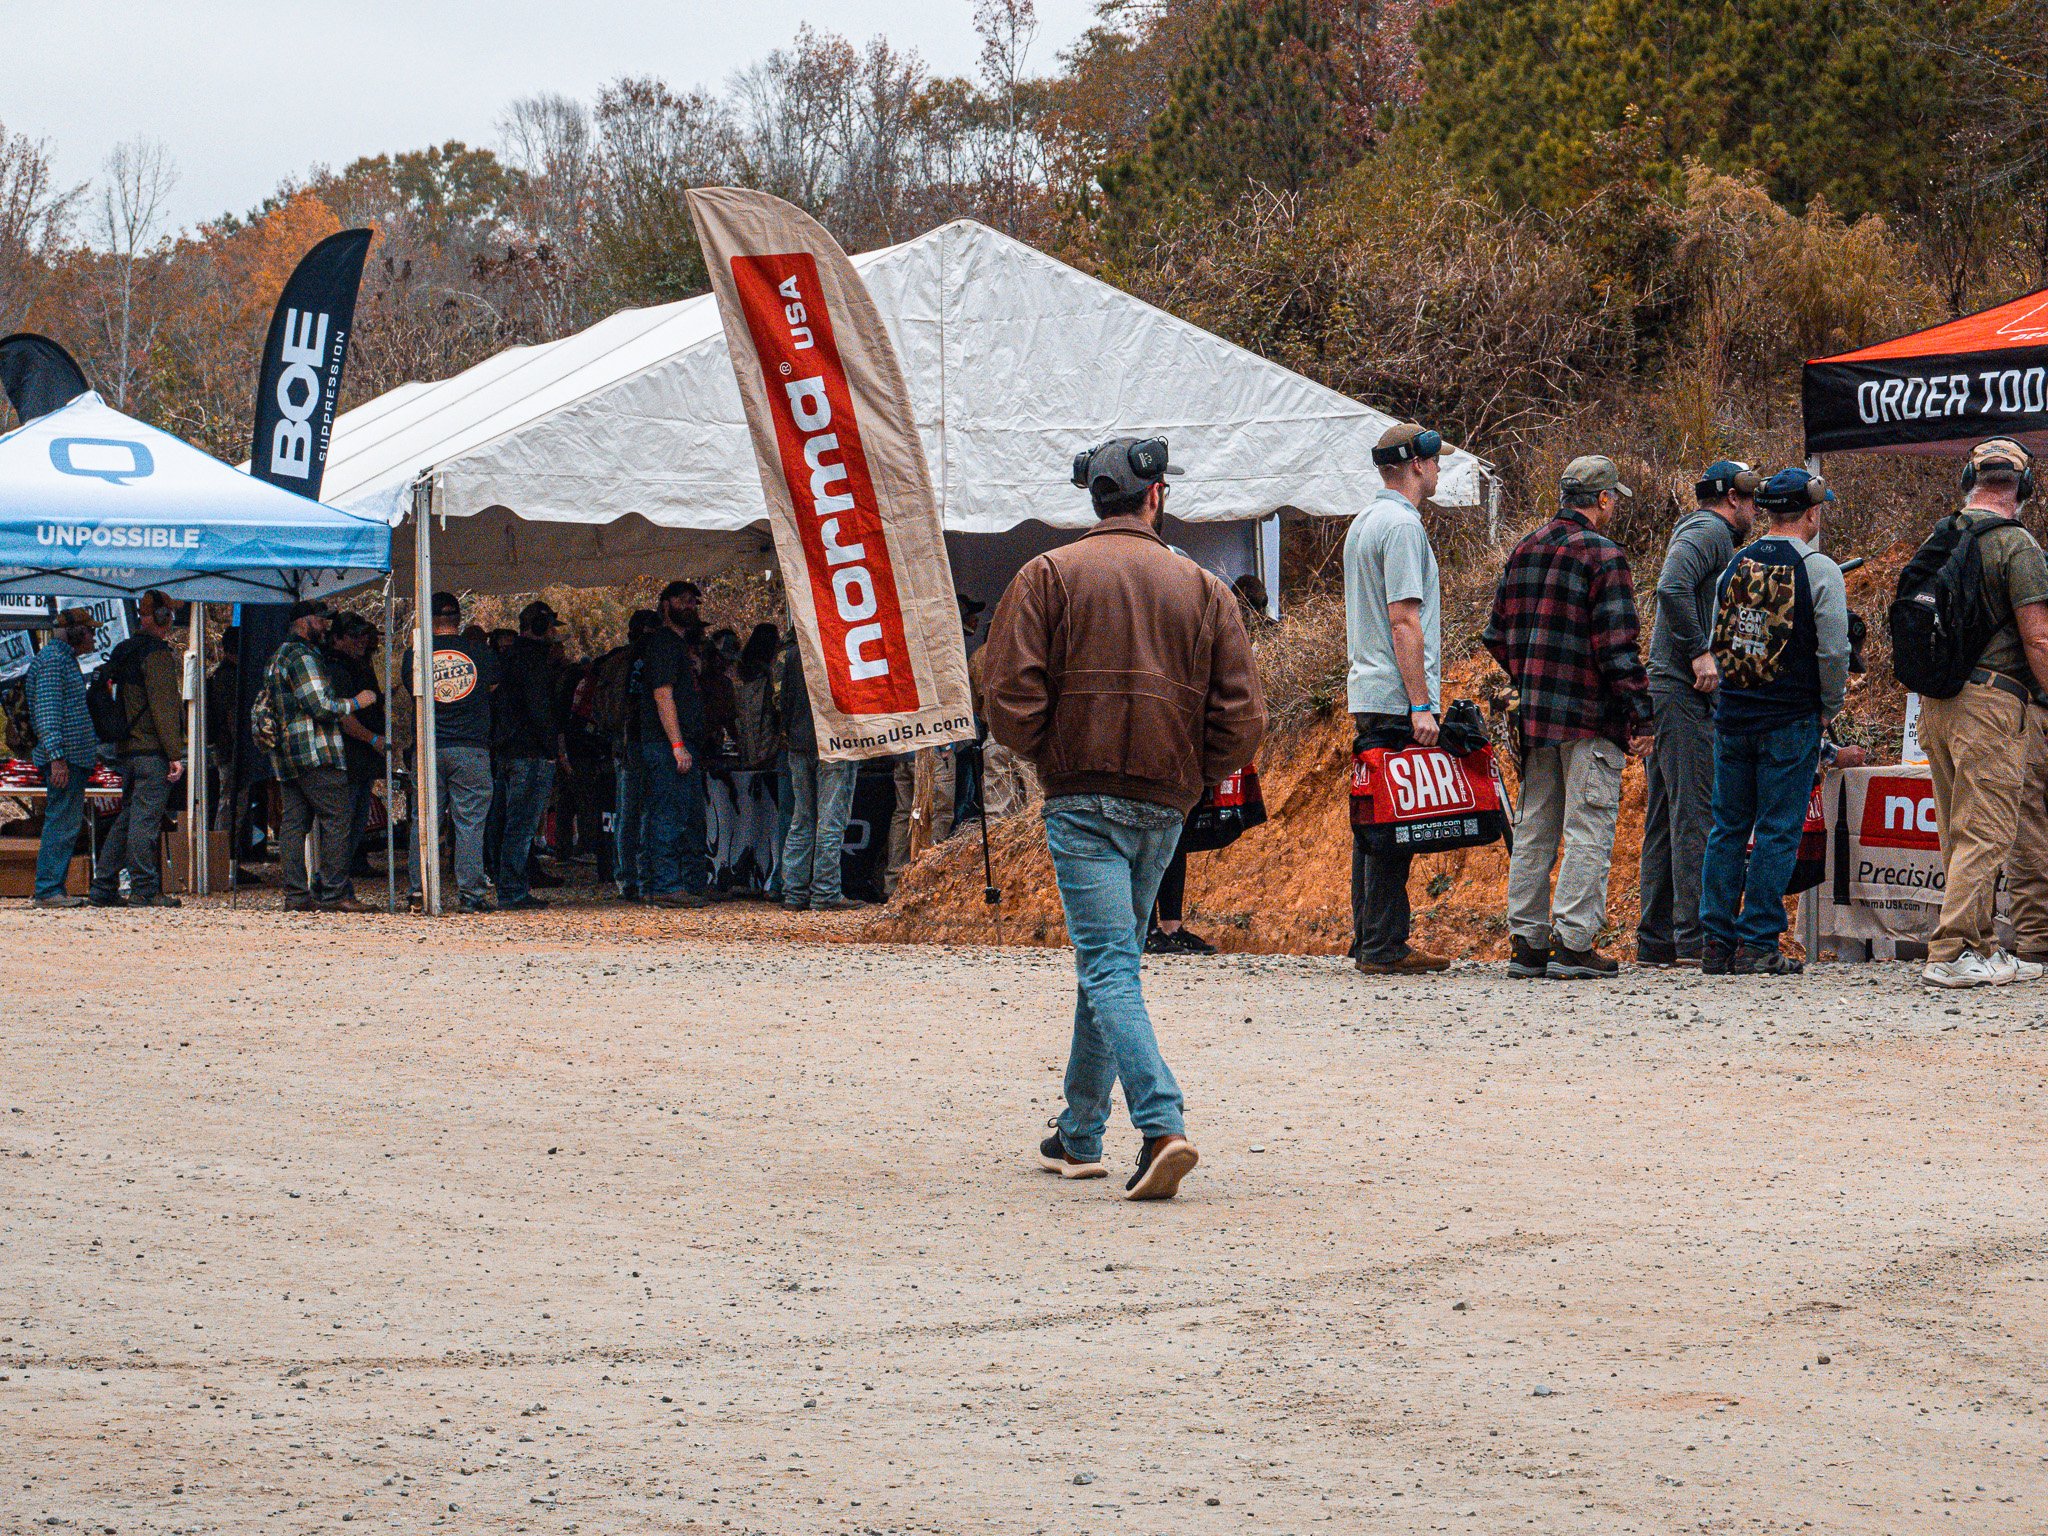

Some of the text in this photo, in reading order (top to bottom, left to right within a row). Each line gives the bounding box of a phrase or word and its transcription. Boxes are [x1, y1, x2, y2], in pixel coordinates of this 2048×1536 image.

[778, 274, 815, 350] USA
[271, 308, 330, 480] BOE
[318, 330, 345, 462] SUPPRESSION
[1857, 367, 2048, 424] ORDER TOD
[36, 525, 200, 549] UNPOSSIBLE
[785, 375, 890, 681] norma
[433, 664, 469, 681] ortex
[828, 715, 970, 752] NormaUSA.com
[1388, 752, 1461, 812] SAR
[1411, 819, 1461, 831] sarusa.com
[1858, 861, 1946, 890] Precisio
